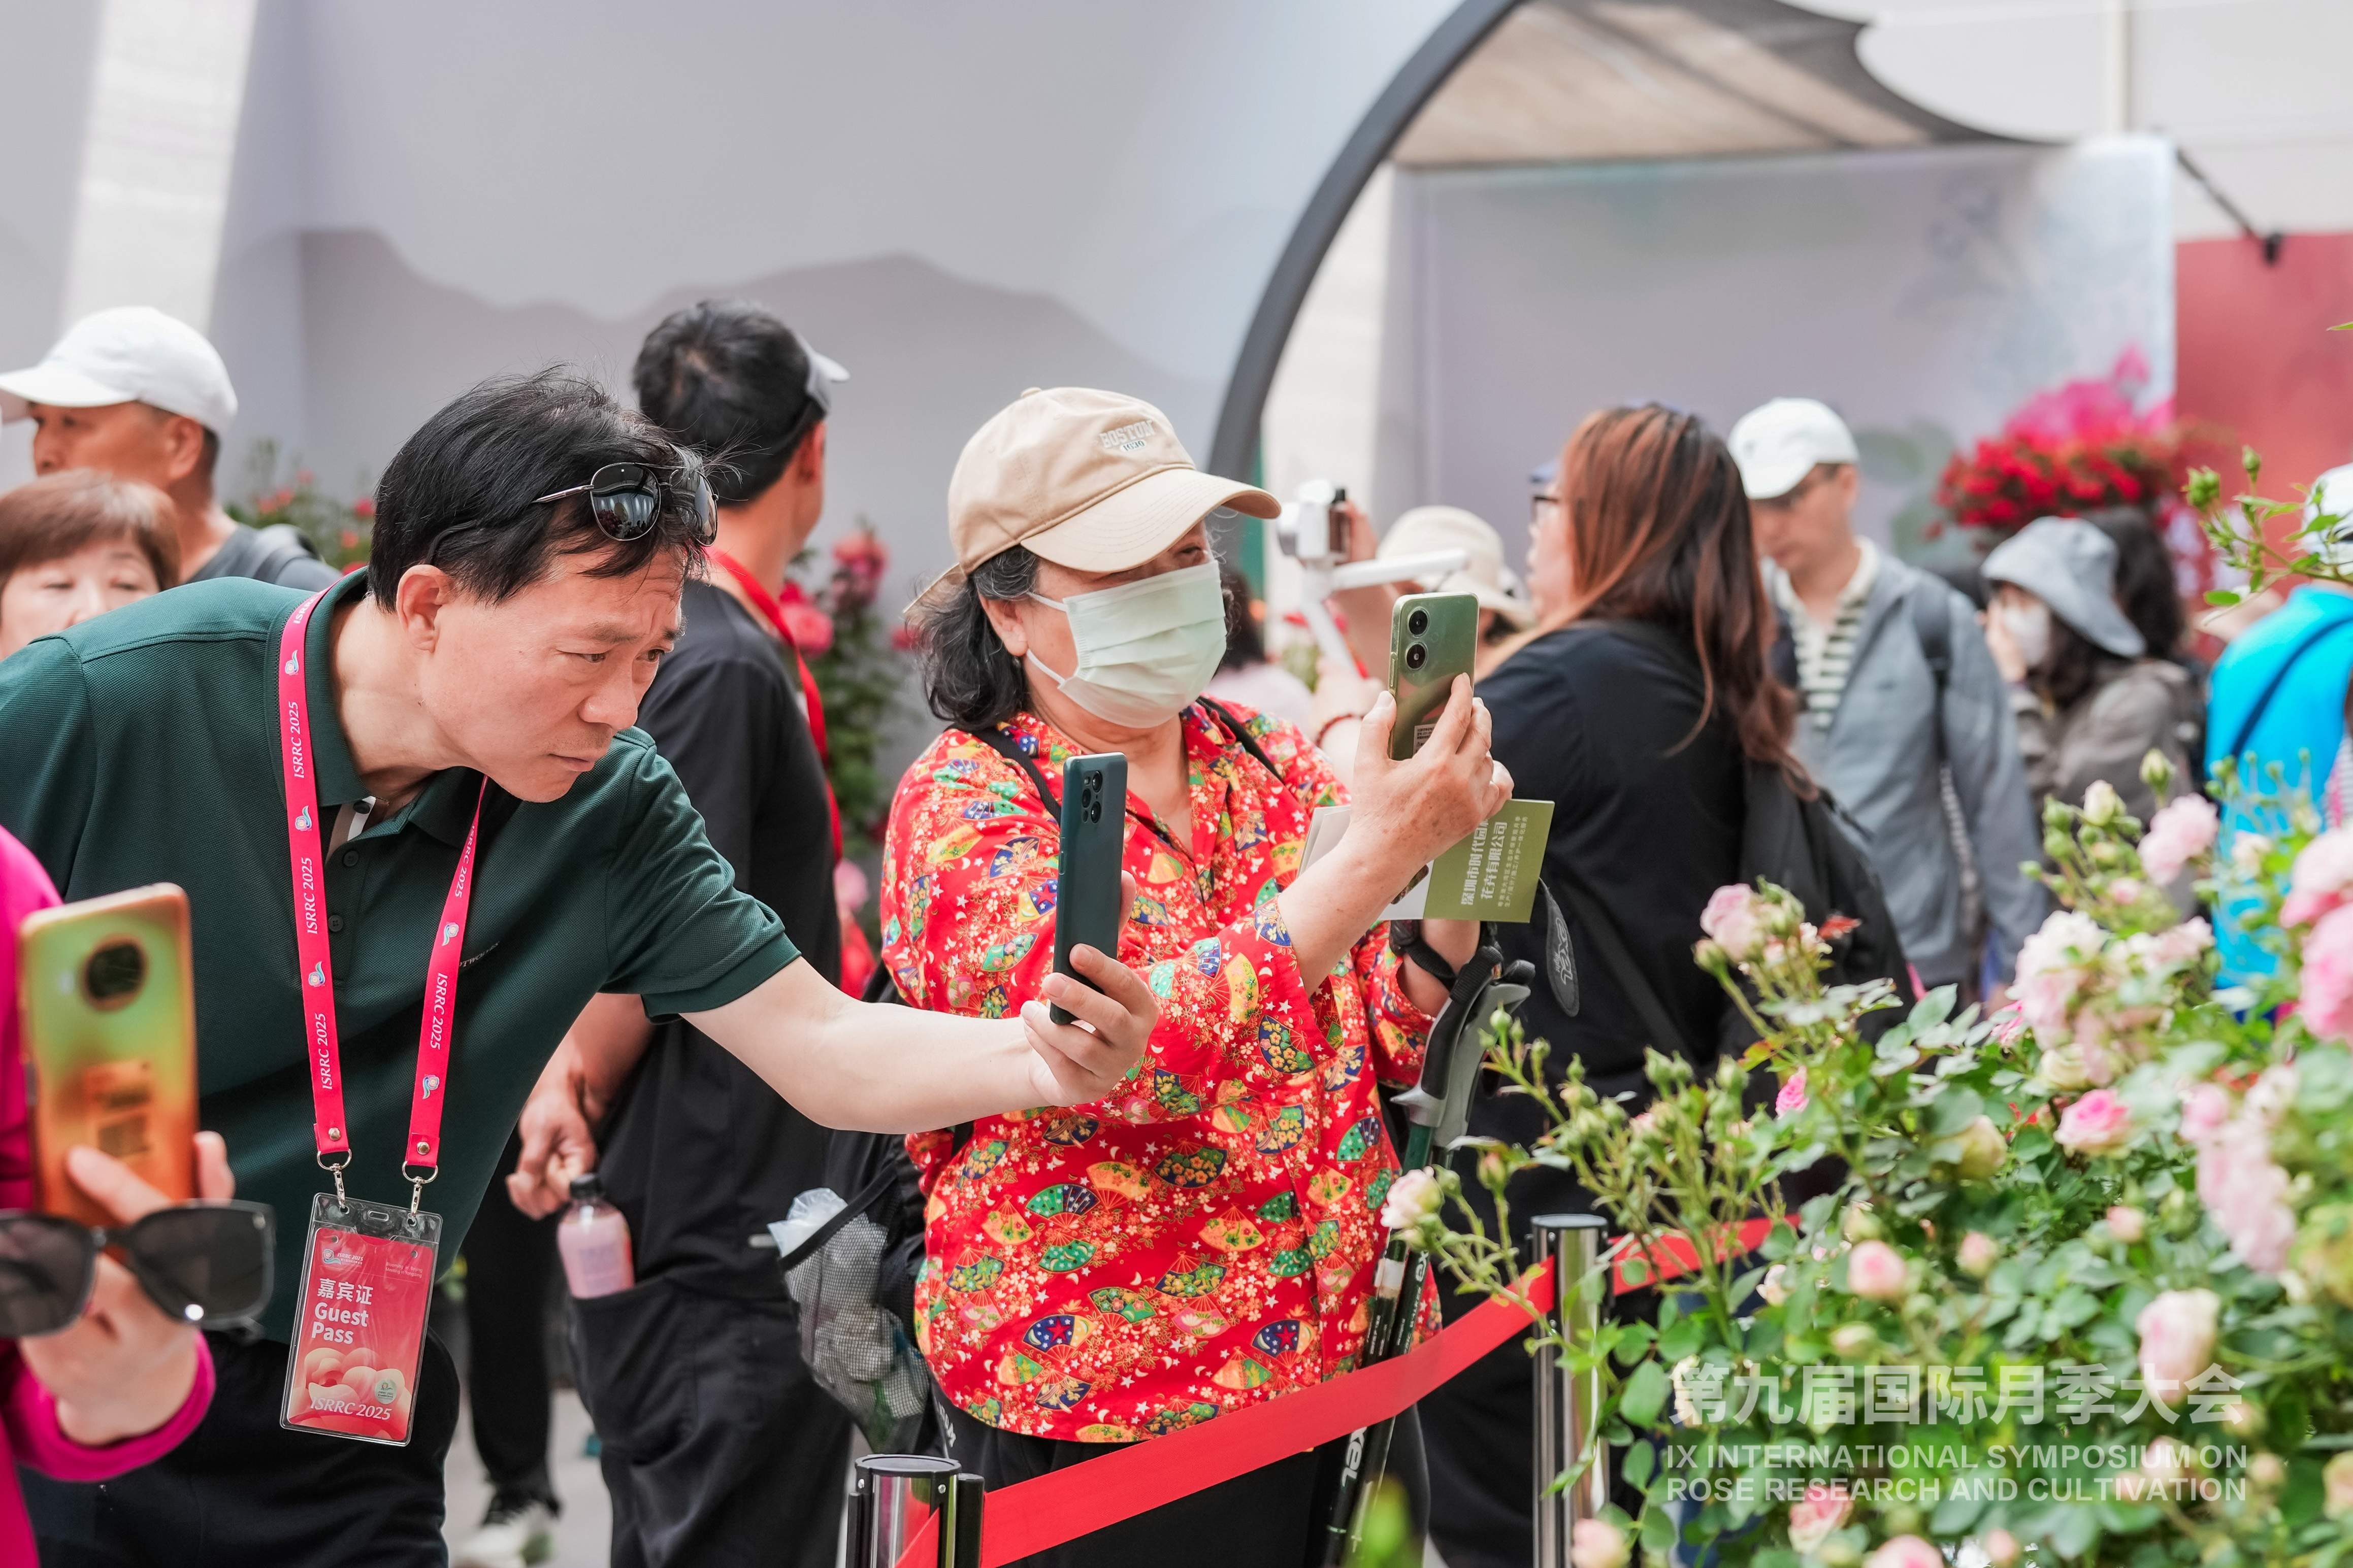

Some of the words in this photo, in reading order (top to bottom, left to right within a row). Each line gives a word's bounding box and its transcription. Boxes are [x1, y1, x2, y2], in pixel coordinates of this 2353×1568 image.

[1098, 420, 1156, 448] BOSTON
[288, 701, 301, 735] 2025
[291, 736, 305, 778] ISRRC
[463, 825, 475, 864] ISRRC
[1480, 821, 1508, 899] 花卉有限公司
[301, 857, 314, 891] 2025
[454, 866, 467, 898] 2025
[303, 892, 318, 935] ISRRC
[434, 972, 448, 1015] ISRRC
[315, 1013, 328, 1047] 2025
[430, 1015, 444, 1050] 2025
[318, 1048, 333, 1090] ISRRC
[317, 1278, 374, 1305] 嘉宾证
[315, 1302, 369, 1327] Guest
[311, 1321, 354, 1344] Pass
[310, 1396, 355, 1415] ISRRC
[355, 1404, 393, 1421] 2025
[1342, 1426, 1367, 1487] xel
